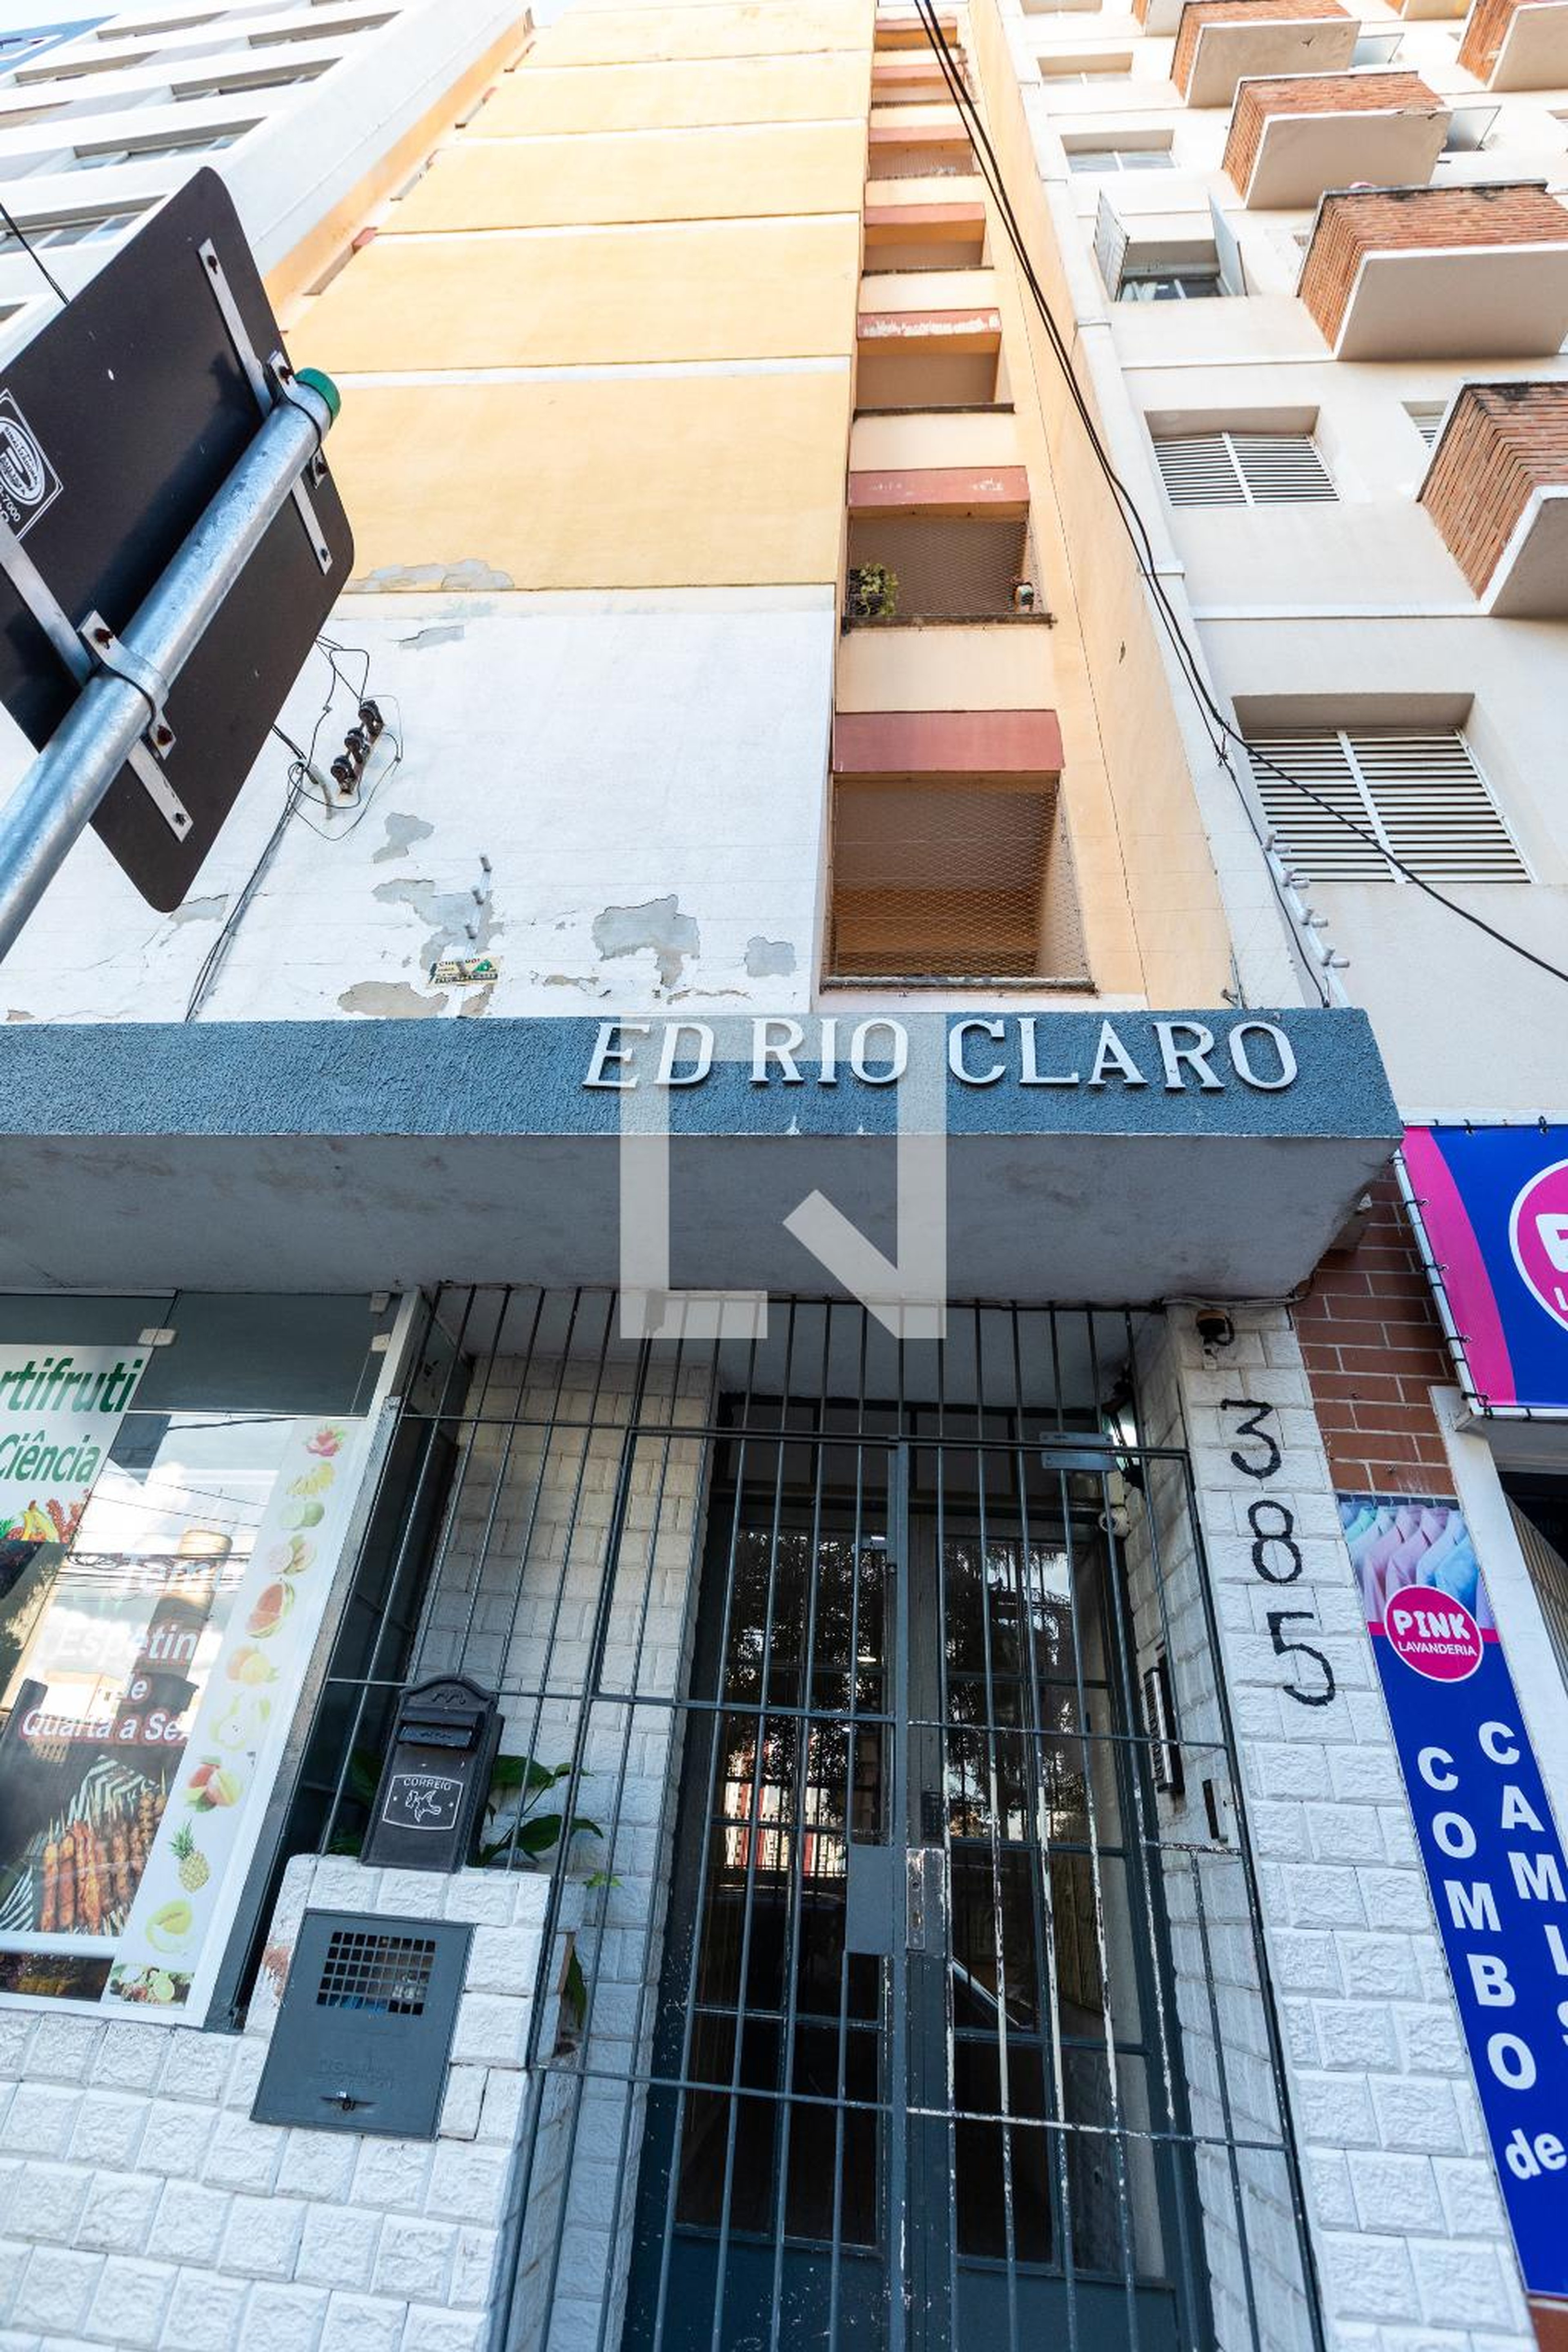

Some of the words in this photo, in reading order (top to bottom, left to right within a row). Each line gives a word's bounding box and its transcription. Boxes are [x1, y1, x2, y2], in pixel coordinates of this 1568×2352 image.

[583, 1022, 715, 1088] ED
[750, 1017, 909, 1084] RIO
[948, 1017, 1298, 1091] CLARO
[1221, 1398, 1336, 1706] 385
[1393, 1610, 1470, 1640] PINK
[1398, 1641, 1477, 1656] LAVANDERIA
[120, 1716, 137, 1740] a
[403, 1777, 451, 1791] CORREIO
[1479, 1721, 1568, 2047] CAMI
[1418, 1746, 1537, 2089] COMBO
[1505, 2128, 1567, 2180] de
